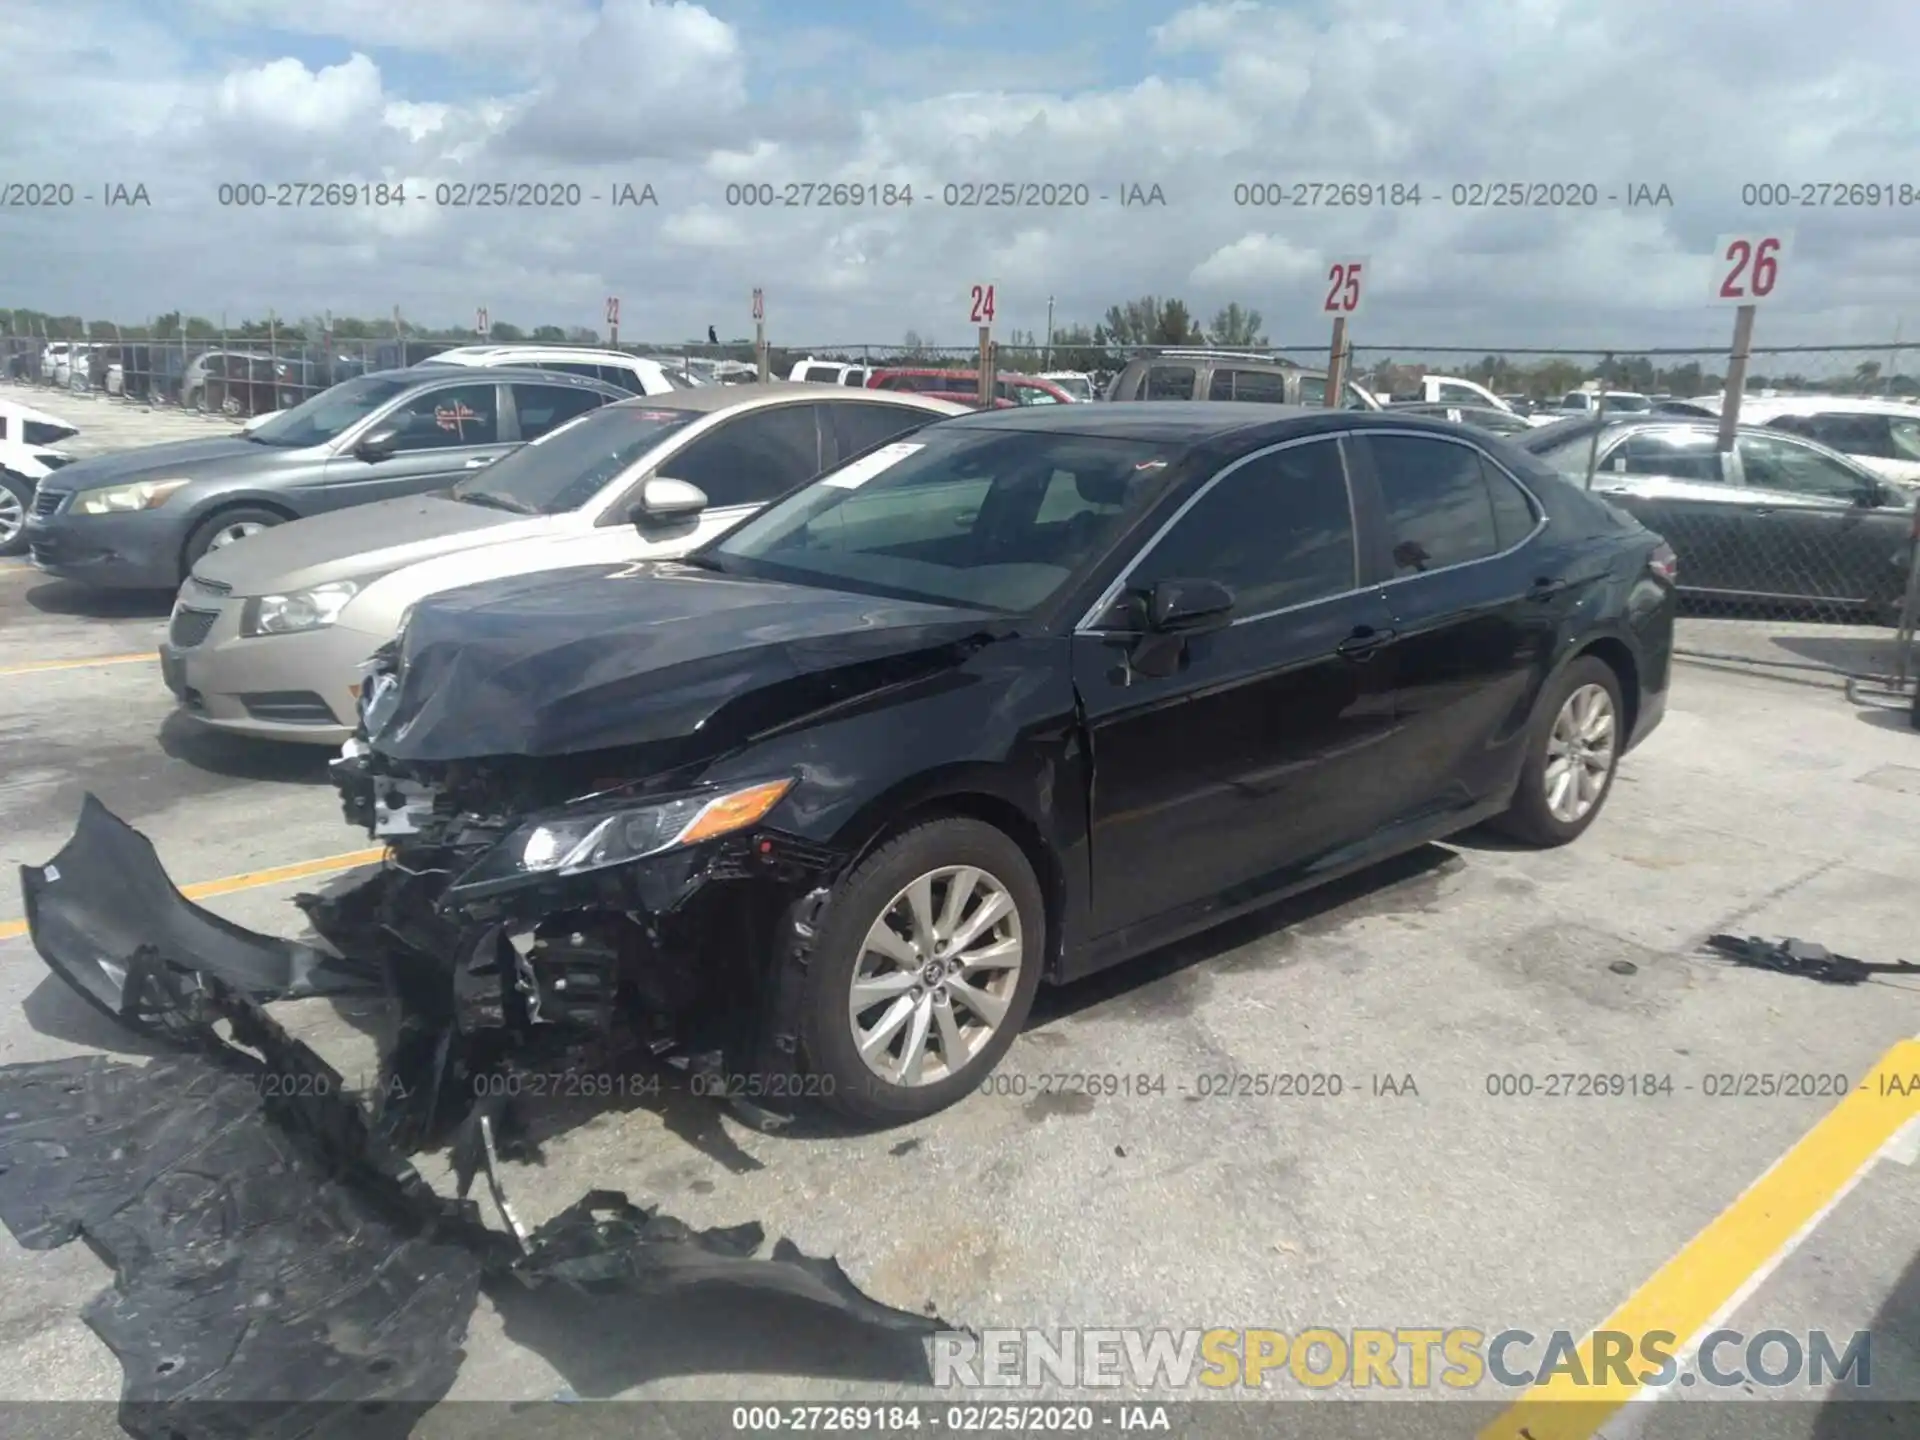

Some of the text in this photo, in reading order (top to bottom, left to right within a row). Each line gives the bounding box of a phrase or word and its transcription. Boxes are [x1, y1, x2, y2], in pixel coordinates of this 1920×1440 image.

[1325, 264, 1362, 312] 25
[1719, 238, 1781, 298] 26
[971, 285, 995, 323] 24
